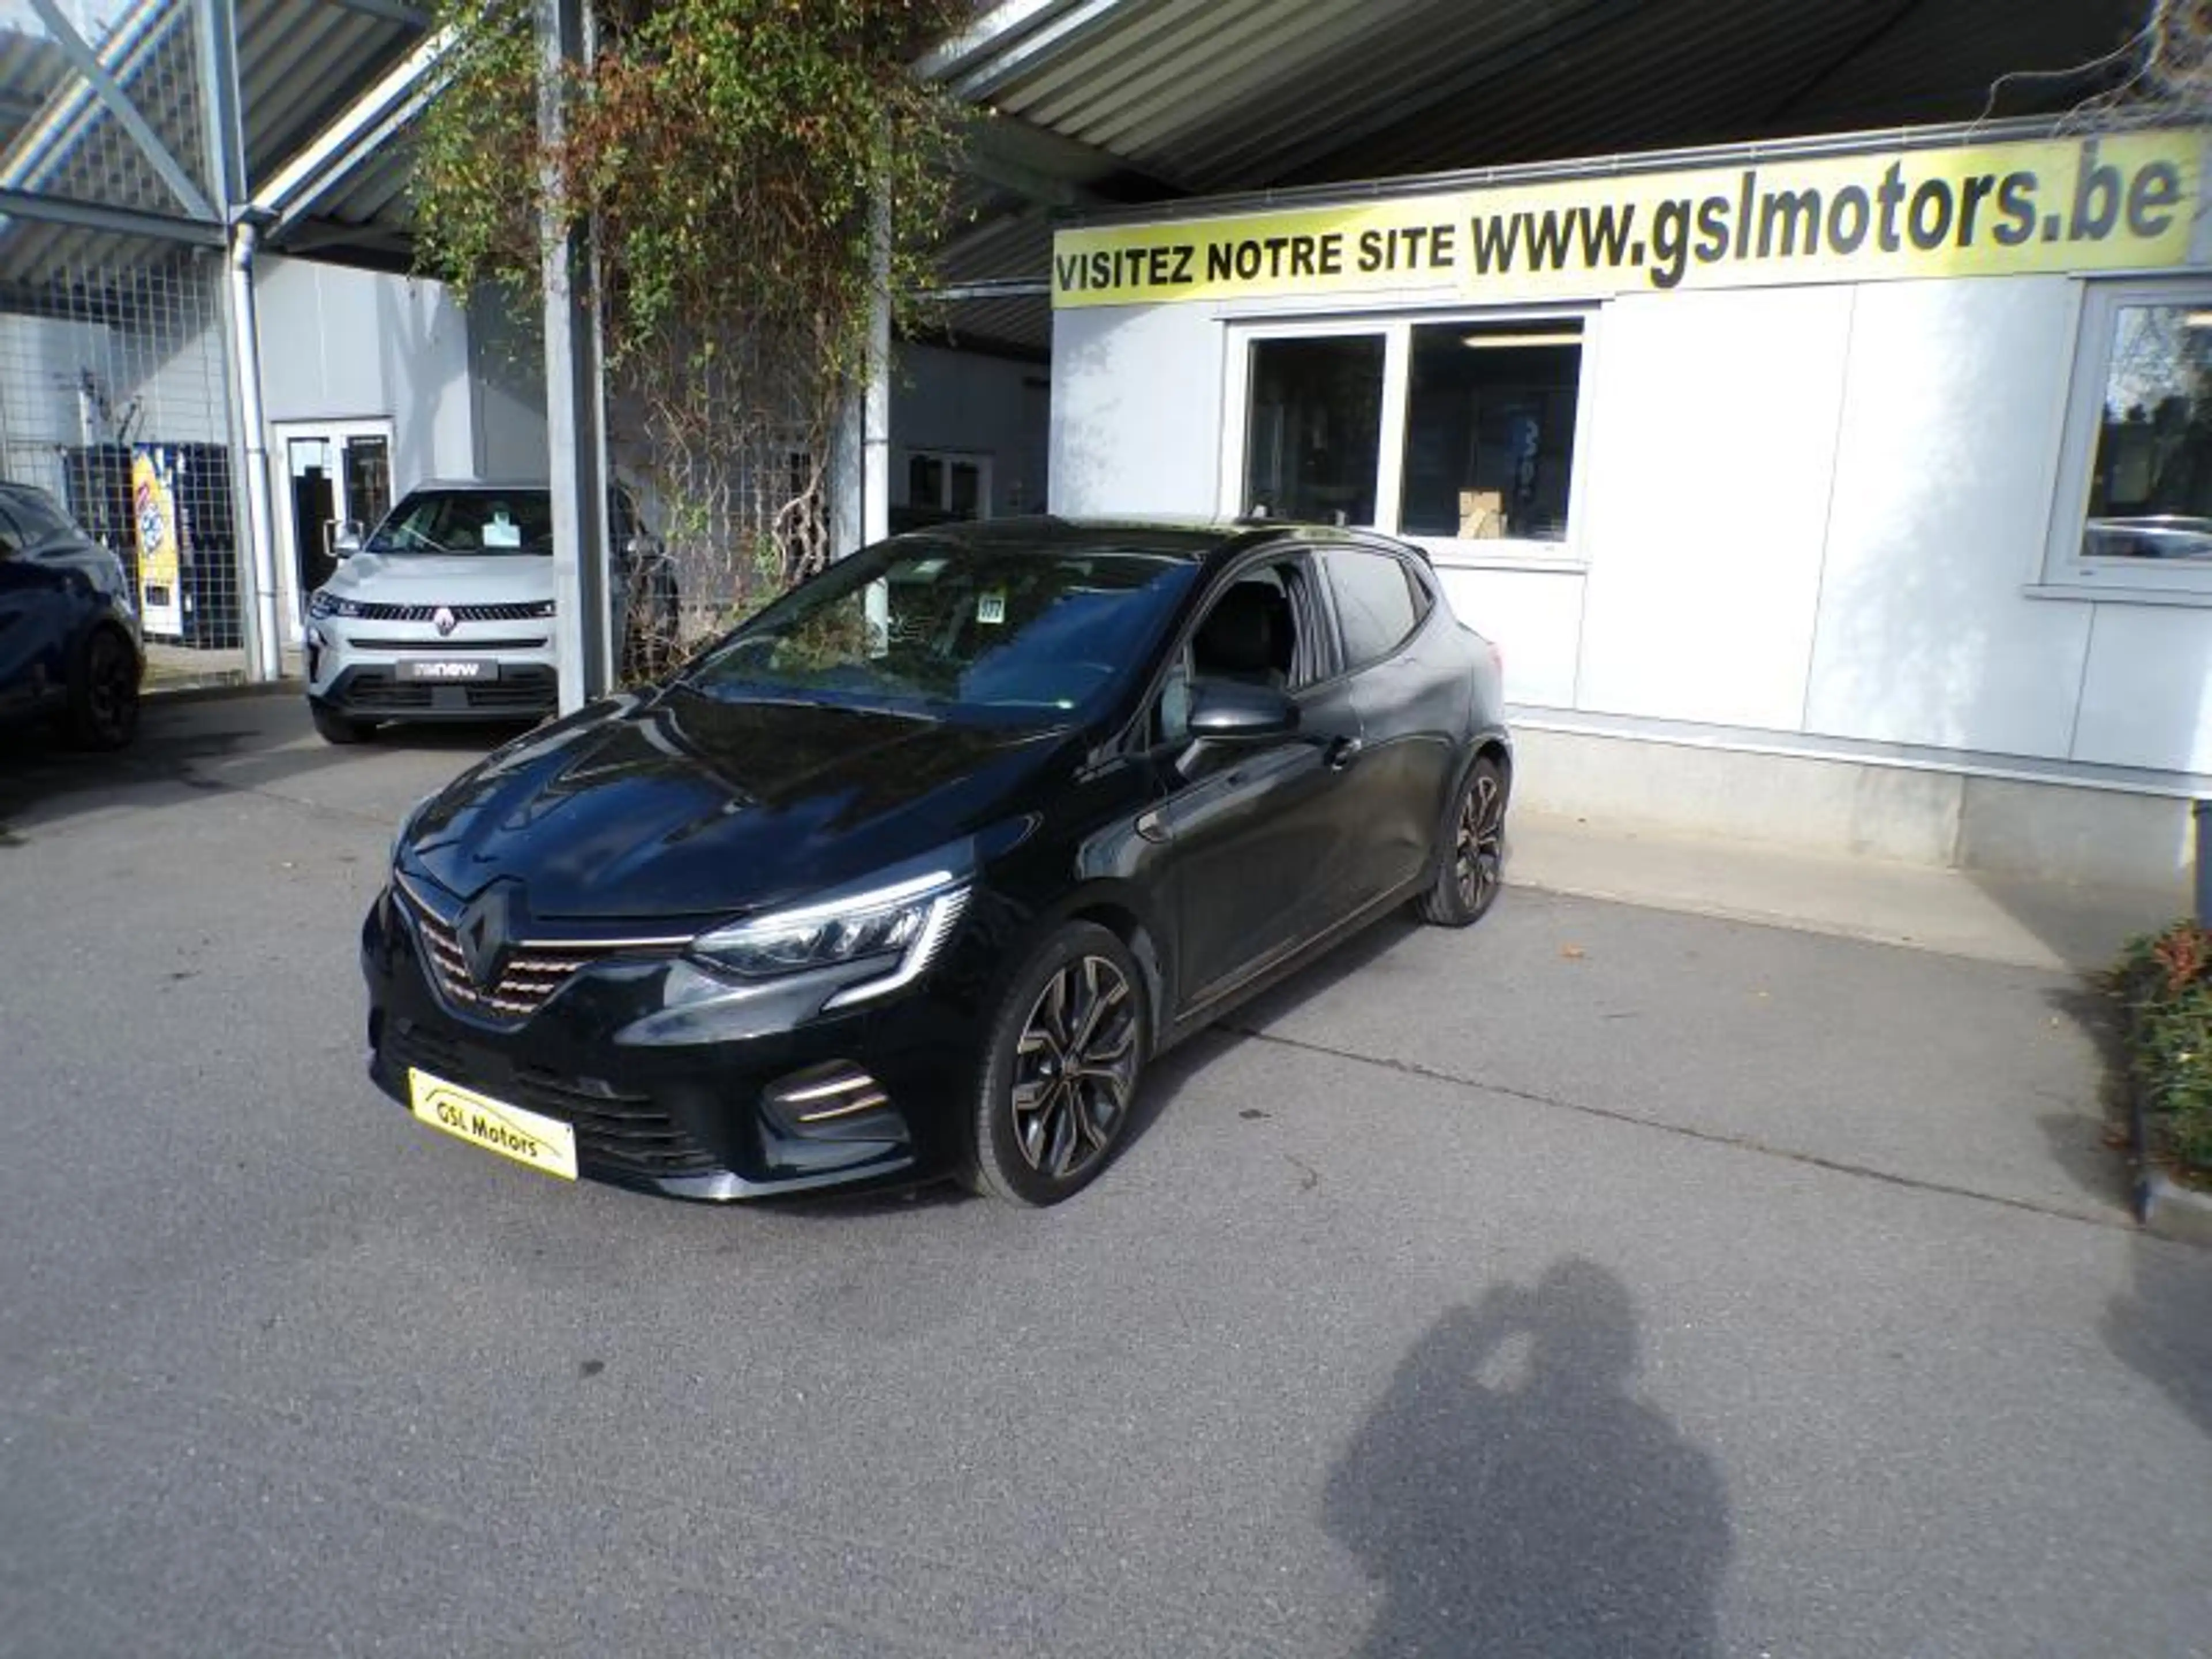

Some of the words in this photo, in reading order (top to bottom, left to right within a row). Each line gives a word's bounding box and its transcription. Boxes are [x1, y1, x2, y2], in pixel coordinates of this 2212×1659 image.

[1056, 245, 1195, 291] VISITEZ
[1207, 234, 1343, 282] NOTRE
[1357, 225, 1455, 272] SITE
[1471, 139, 2181, 289] www.gslmotors.be
[437, 1101, 468, 1131] GSL
[472, 1115, 537, 1157] Motors
